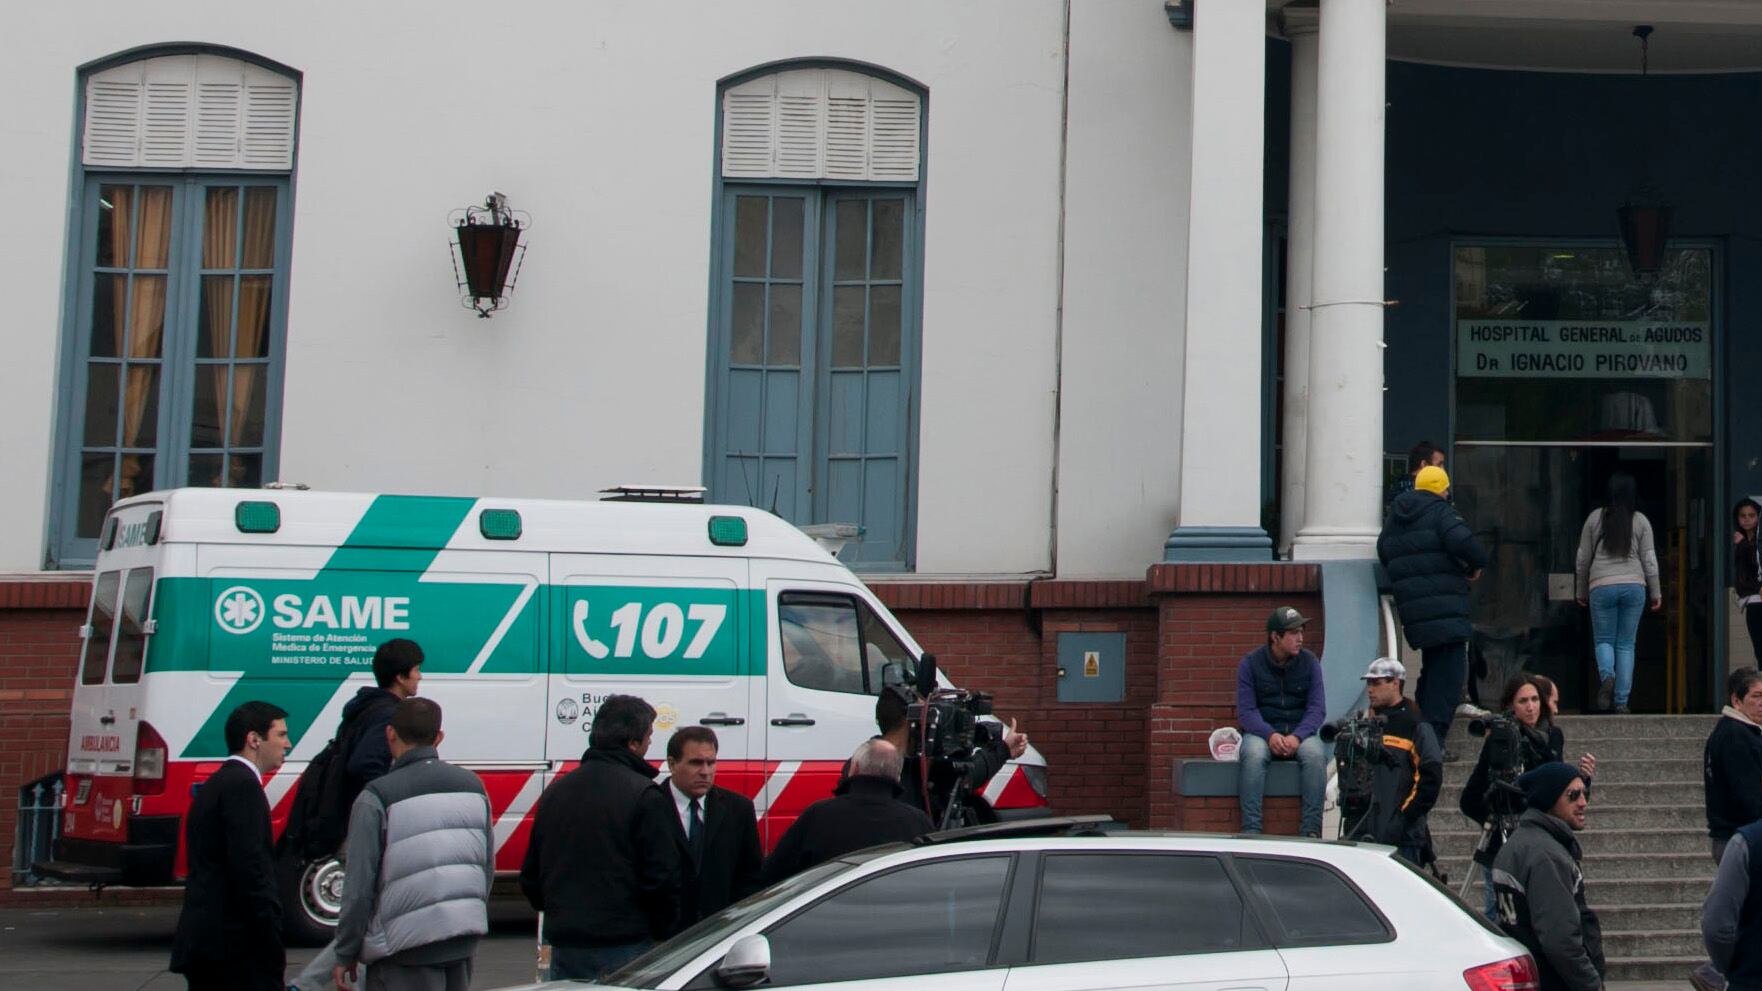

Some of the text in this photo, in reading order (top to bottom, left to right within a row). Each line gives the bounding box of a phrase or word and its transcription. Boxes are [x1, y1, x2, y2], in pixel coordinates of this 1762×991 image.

[1470, 326, 1549, 342] HOSPITAL
[1560, 327, 1626, 343] GENERAL
[1644, 328, 1703, 343] AGUDOS
[1511, 353, 1585, 371] IGNACIO
[1596, 354, 1688, 371] PIROVANO
[272, 594, 410, 629] SAME
[272, 633, 367, 642] Sistema de Atención
[610, 602, 727, 659] 107
[309, 643, 320, 651] de
[322, 643, 376, 654] Emergencia
[272, 656, 327, 664] MINISTERIO
[329, 656, 341, 664] DE
[81, 735, 120, 752] AMBULANCIA
